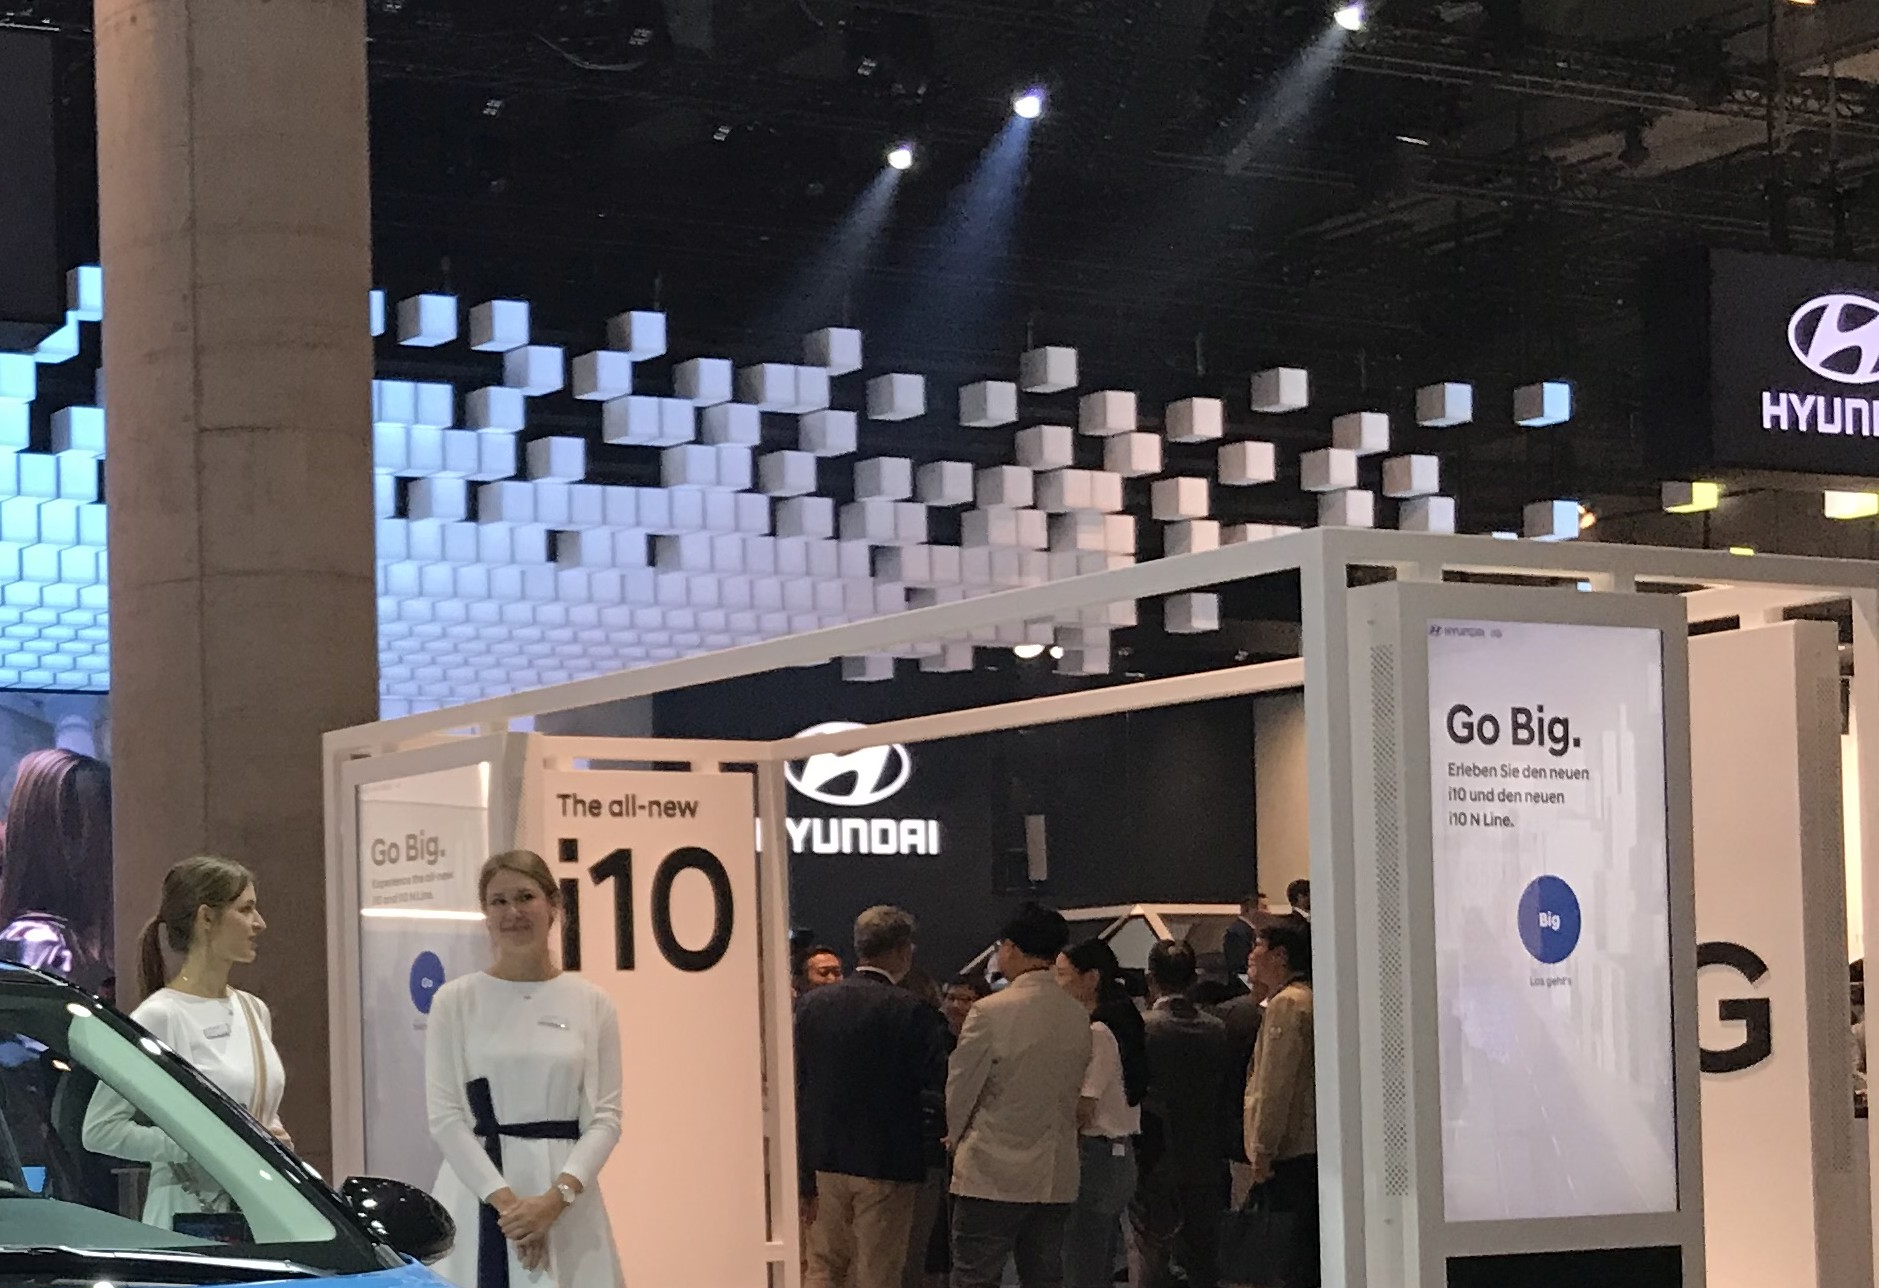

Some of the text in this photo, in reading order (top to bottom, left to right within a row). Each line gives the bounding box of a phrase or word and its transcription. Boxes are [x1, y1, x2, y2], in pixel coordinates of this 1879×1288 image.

[1762, 391, 1879, 437] HYUN
[1447, 704, 1581, 756] Go Big.
[1448, 762, 1590, 780] Erleben Sie den neuen
[557, 794, 699, 818] The all-new
[1470, 788, 1495, 803] und
[1497, 789, 1522, 803] den
[1524, 792, 1565, 804] neuen
[1470, 813, 1480, 826] N
[1483, 813, 1515, 827] Line.
[371, 829, 446, 866] Go Big.
[754, 817, 939, 855] YUNDAI
[558, 838, 734, 972] i10
[1539, 910, 1560, 931] Big
